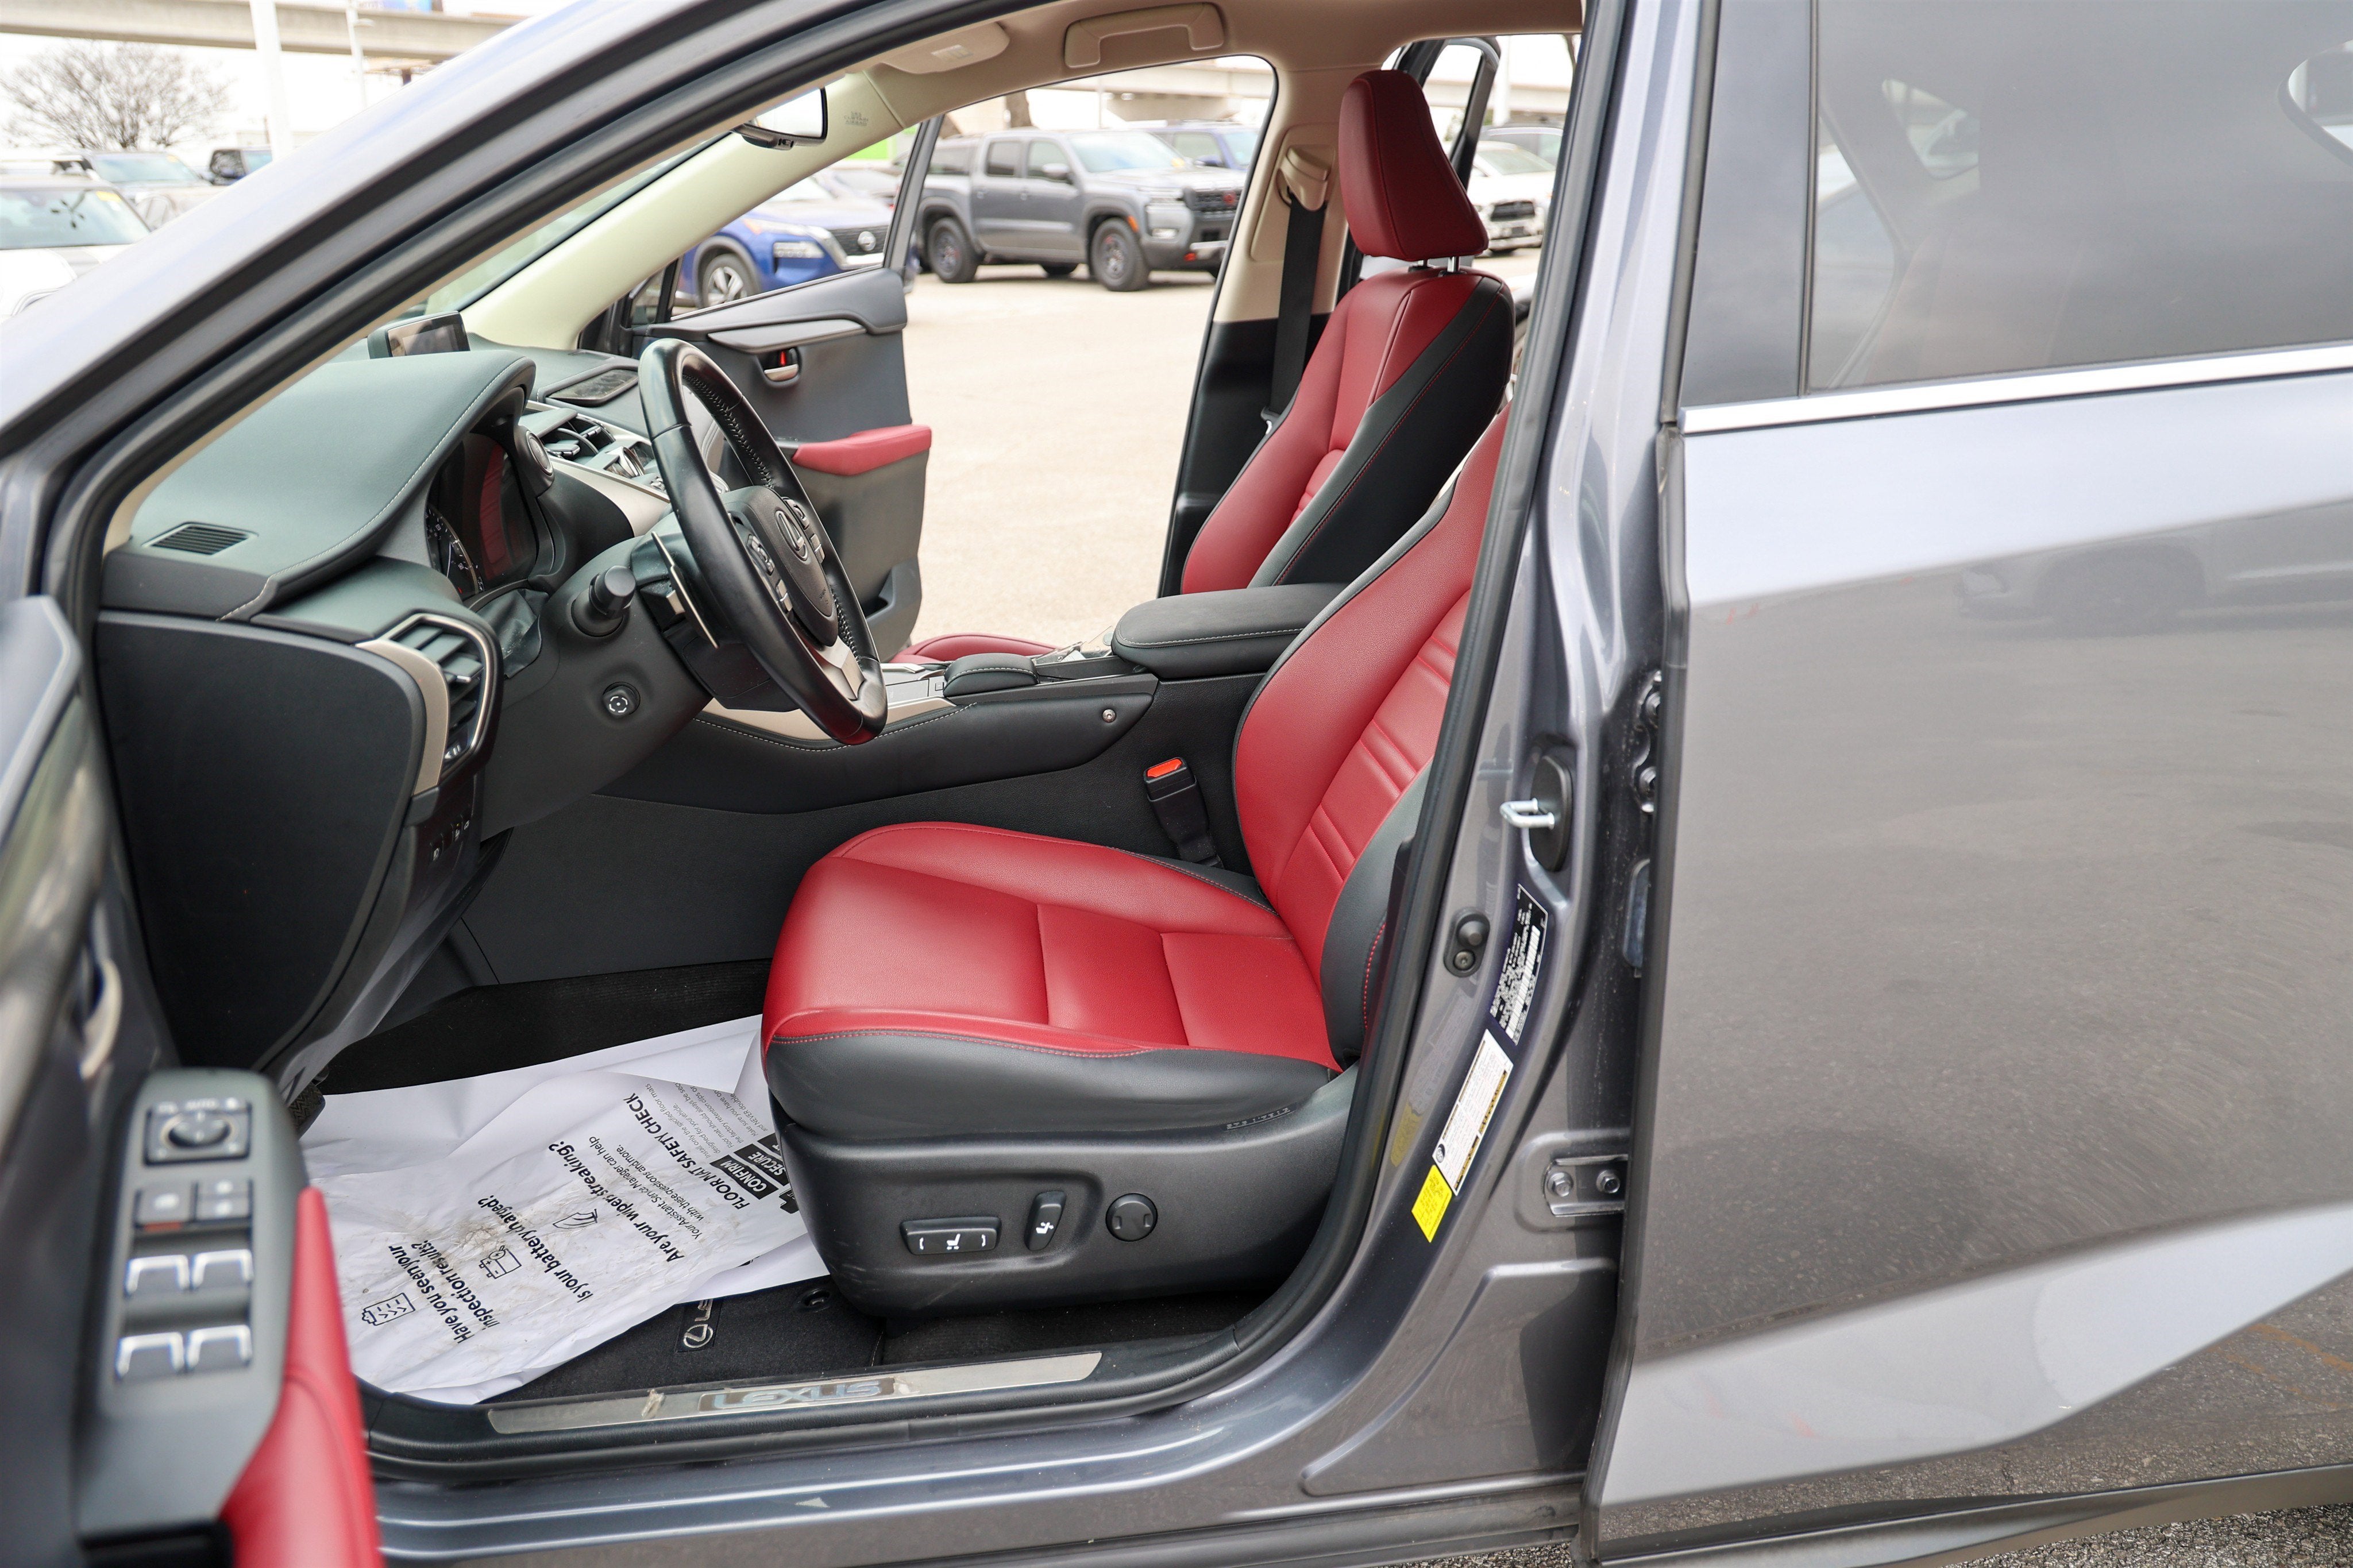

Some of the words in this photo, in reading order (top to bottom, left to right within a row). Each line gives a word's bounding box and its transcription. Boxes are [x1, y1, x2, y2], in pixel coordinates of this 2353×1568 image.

[645, 1083, 657, 1098] mats
[683, 1093, 691, 1102] be
[695, 1092, 707, 1103] clips
[654, 1098, 667, 1113] floor
[688, 1100, 704, 1113] always
[720, 1096, 732, 1110] have
[623, 1092, 662, 1134] CHECK
[663, 1111, 684, 1127] specified
[704, 1102, 724, 1122] retention
[729, 1108, 741, 1117] you
[743, 1109, 760, 1126] NEVER
[685, 1117, 699, 1127] your
[699, 1113, 717, 1129] should
[737, 1117, 749, 1126] sure
[681, 1126, 691, 1136] the
[694, 1127, 703, 1135] for
[713, 1128, 725, 1138] mat
[721, 1122, 738, 1138] factory
[746, 1126, 759, 1137] Make
[589, 1136, 607, 1156] help
[688, 1135, 699, 1146] only
[699, 1134, 721, 1154] designed
[722, 1137, 735, 1148] Floor
[616, 1144, 635, 1164] more.
[654, 1132, 697, 1169] SAFETY
[695, 1145, 711, 1159] Install
[603, 1153, 617, 1166] can
[628, 1160, 646, 1173] and
[748, 1152, 786, 1176] SECURE
[548, 1141, 609, 1197] streaking?
[613, 1165, 642, 1189] Manager
[688, 1167, 717, 1181] MAT
[720, 1160, 767, 1192] CONFIRM
[670, 1193, 691, 1209] these
[709, 1177, 750, 1210] FLOOR
[477, 1195, 526, 1233] charged?
[657, 1201, 690, 1226] Assistant
[686, 1207, 704, 1222] with
[633, 1222, 669, 1244] your
[684, 1224, 703, 1240] Your
[388, 1246, 421, 1269] your
[411, 1239, 454, 1276] results?
[518, 1230, 561, 1273] battery
[659, 1241, 685, 1262] Are
[407, 1265, 435, 1294] seen
[553, 1269, 589, 1294] your
[426, 1292, 458, 1316] you
[445, 1272, 500, 1331] inspection
[577, 1290, 593, 1303] Is
[445, 1315, 475, 1344] Have
[713, 1380, 881, 1410] LEXUS
